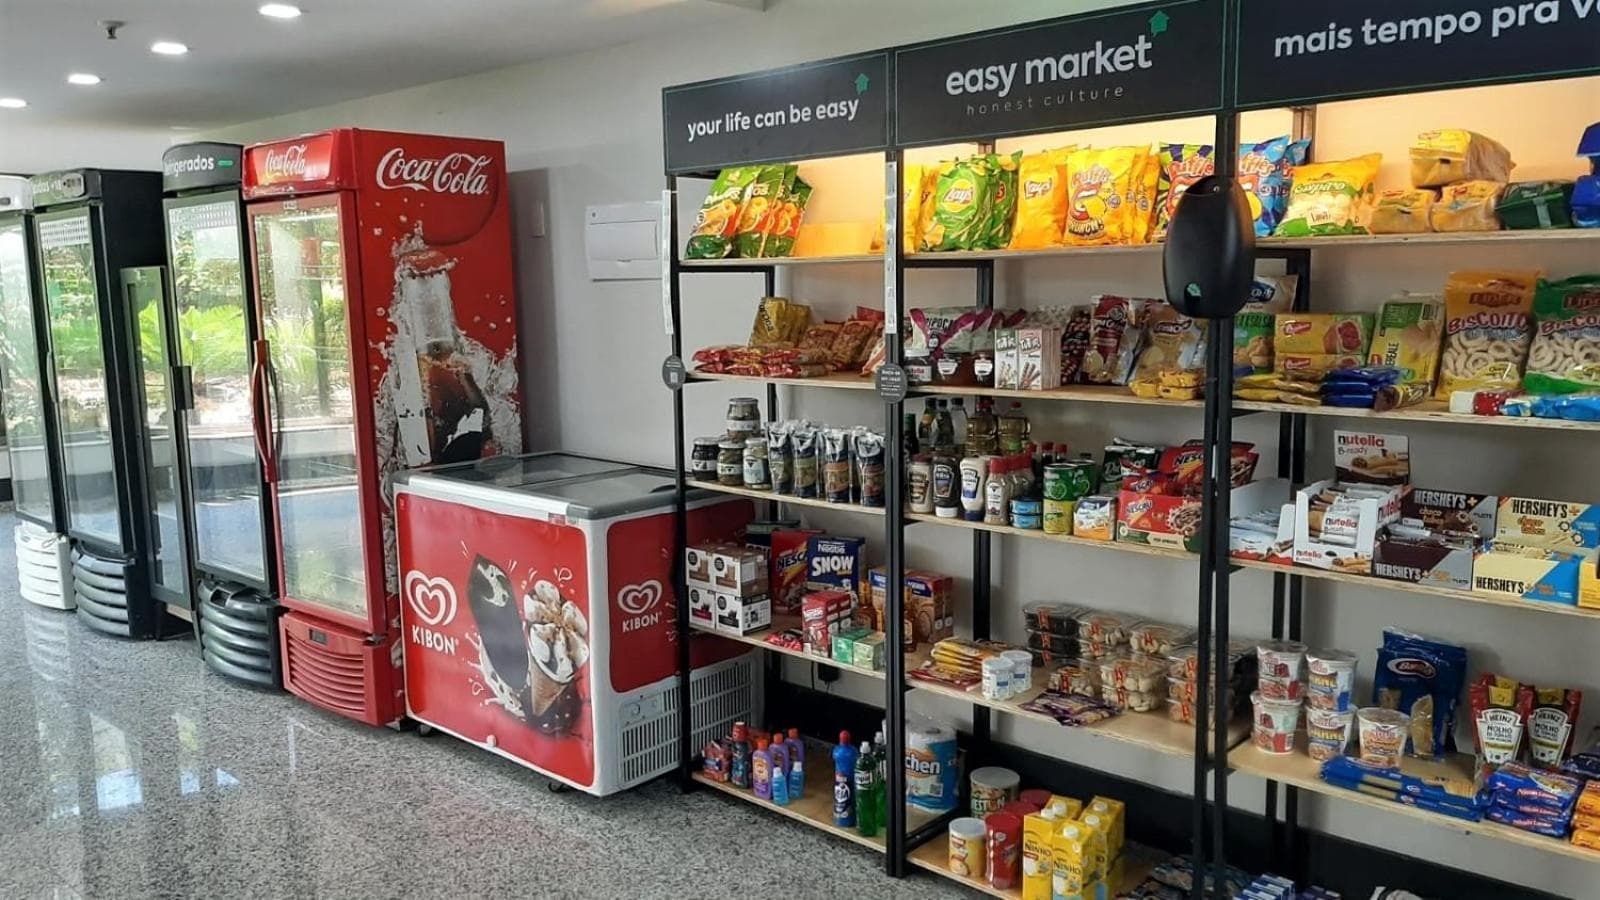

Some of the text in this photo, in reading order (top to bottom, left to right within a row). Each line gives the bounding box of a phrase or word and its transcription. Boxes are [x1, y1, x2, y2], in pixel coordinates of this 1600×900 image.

[1274, 0, 1600, 58] mais tempo pra v
[945, 35, 1153, 98] easy market
[966, 87, 1124, 116] honest culture
[687, 98, 860, 142] your life can be easy
[1168, 154, 1215, 178] Ruffle
[1239, 153, 1275, 175] ffles
[1540, 315, 1600, 337] BISCO
[1338, 434, 1385, 448] nutella
[1173, 452, 1204, 470] NESC
[1413, 489, 1467, 510] HERSHEY'S
[1512, 501, 1568, 519] HERSHEY'S
[1325, 517, 1358, 530] nutella
[776, 551, 809, 570] NESC
[1296, 549, 1322, 560] nutella
[812, 556, 854, 577] SNOW
[1375, 561, 1422, 582] HERSHEY'S
[1475, 577, 1524, 596] HERSHEY'S
[622, 613, 659, 633] KIBON
[411, 624, 457, 656] KIBON
[1488, 712, 1513, 723] HEINZ
[1537, 711, 1562, 723] HEINZ
[1487, 724, 1513, 734] MOLHO
[905, 752, 941, 775] chen
[1025, 841, 1052, 858] NINHO
[1054, 860, 1080, 875] NINHO
